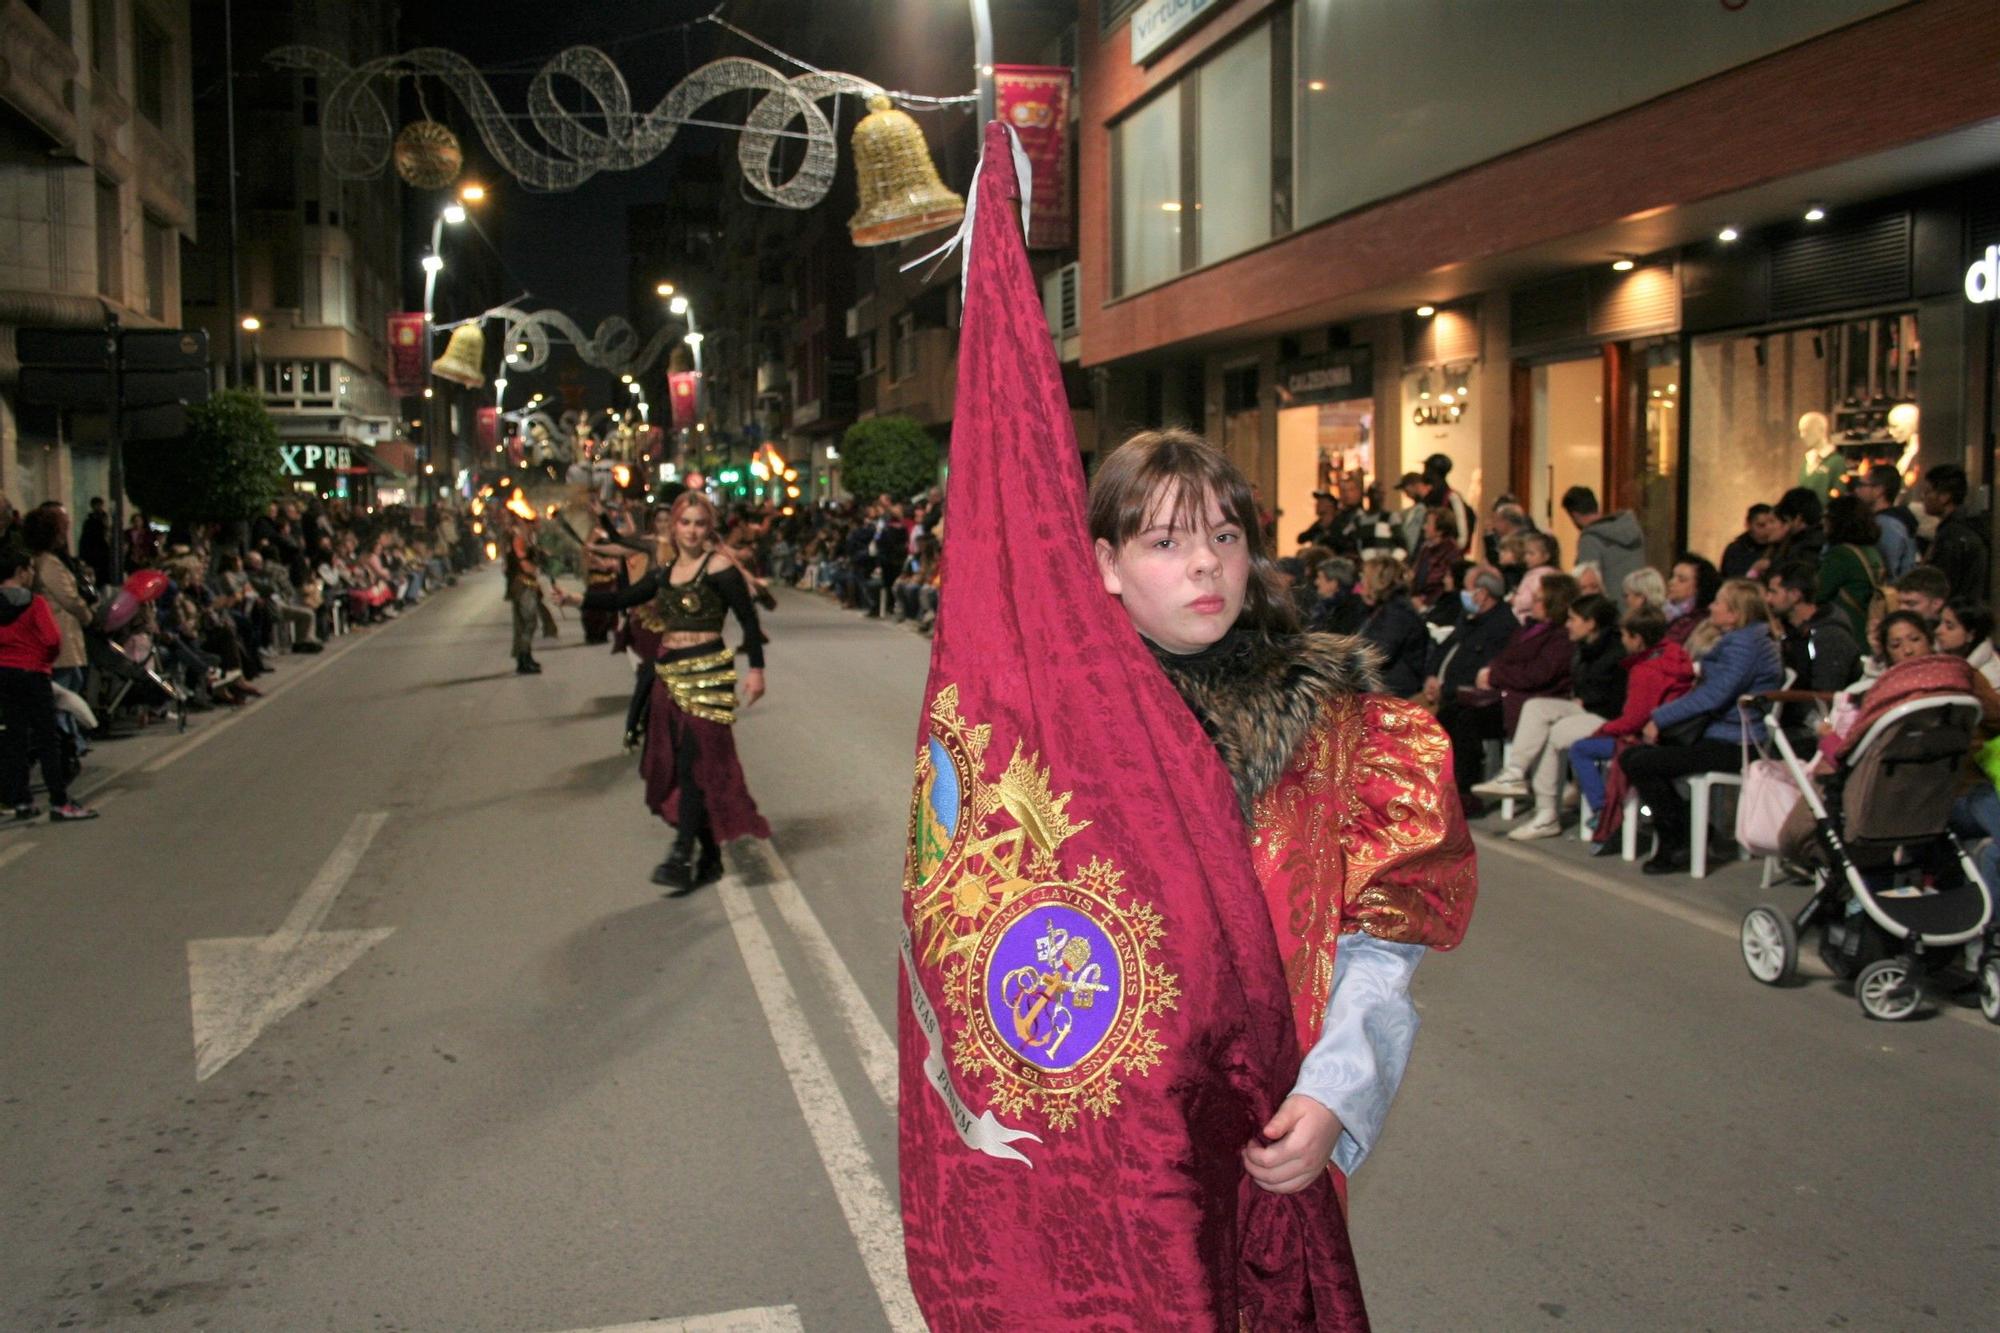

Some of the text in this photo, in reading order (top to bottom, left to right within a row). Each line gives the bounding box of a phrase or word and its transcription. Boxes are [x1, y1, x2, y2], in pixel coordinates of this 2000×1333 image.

[951, 747, 972, 798] LORCA
[1031, 889, 1093, 912] CLAVIS
[970, 900, 1027, 998] TVTISSIMA
[1115, 932, 1138, 996] ENSIS
